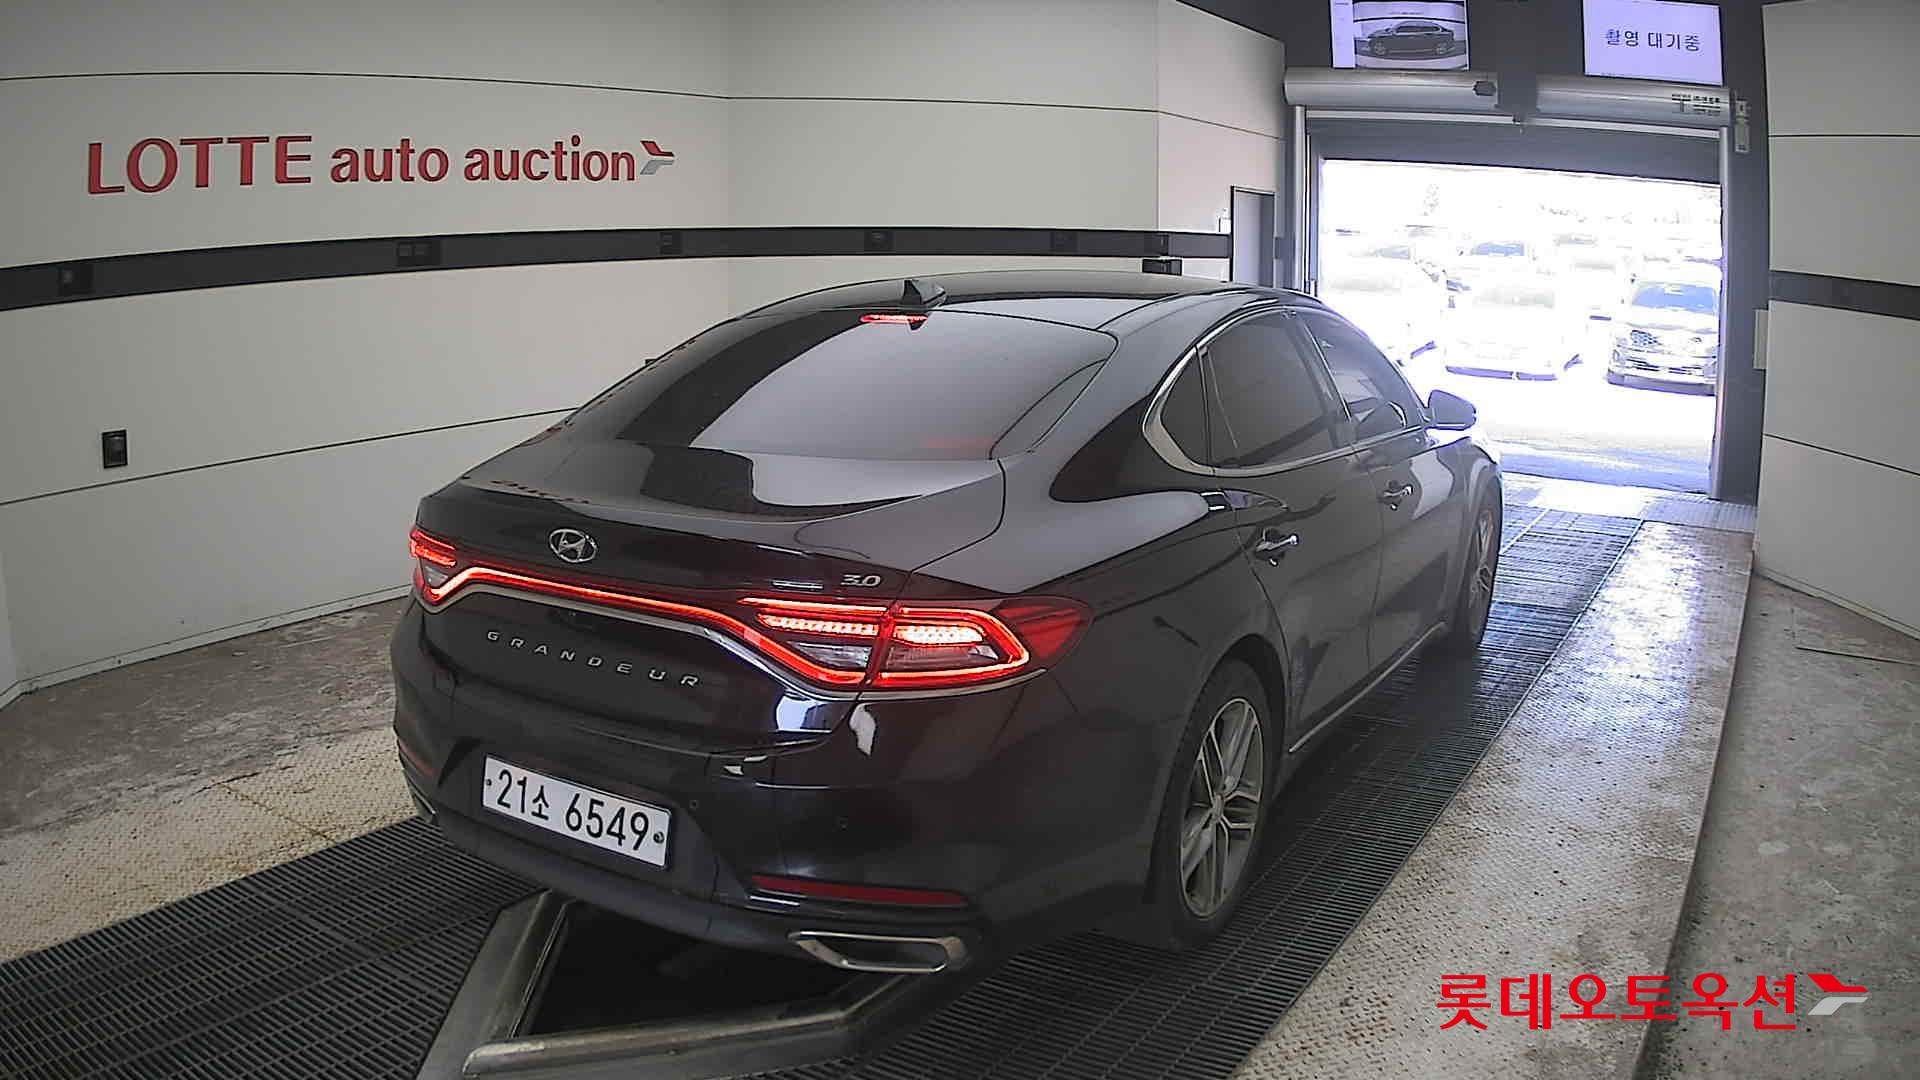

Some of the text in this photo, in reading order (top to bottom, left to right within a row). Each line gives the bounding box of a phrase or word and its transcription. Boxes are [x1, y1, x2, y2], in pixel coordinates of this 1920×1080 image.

[1647, 32, 1701, 52] 대기중
[88, 135, 636, 195] LOTTE auto auction
[487, 631, 699, 686] GRANDEUR
[497, 769, 649, 851] 21소 6549
